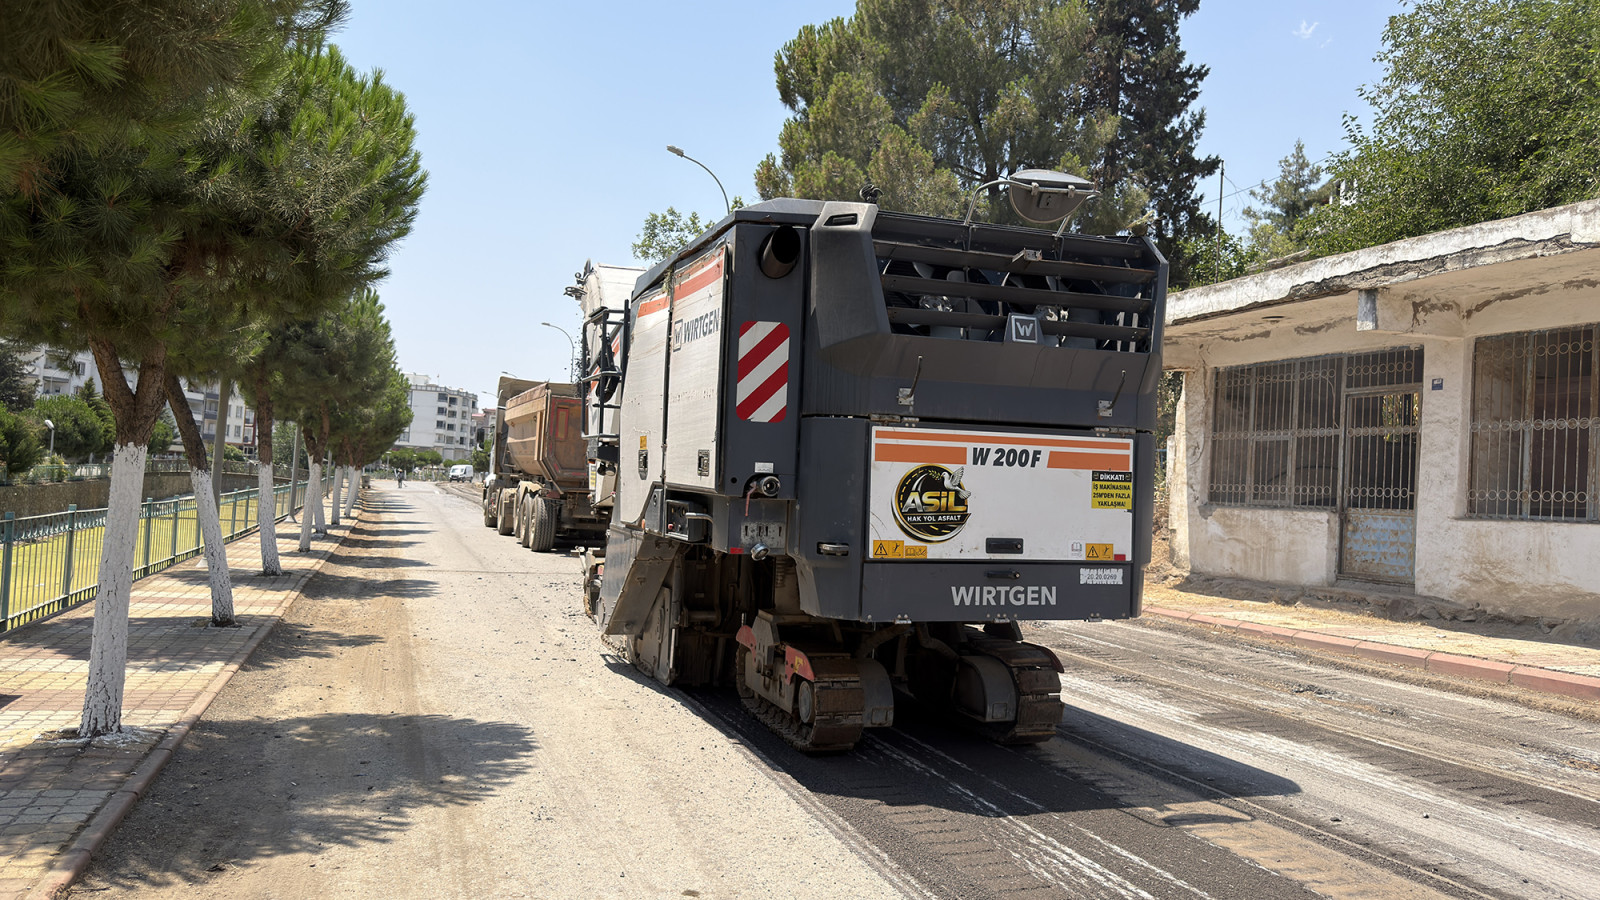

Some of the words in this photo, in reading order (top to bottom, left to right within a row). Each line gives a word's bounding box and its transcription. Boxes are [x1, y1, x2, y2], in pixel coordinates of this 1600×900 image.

[684, 307, 720, 343] WIRTGEN
[1015, 321, 1034, 337] W
[972, 447, 991, 466] W
[993, 447, 1042, 468] 200F
[1099, 473, 1125, 481] DİKKAT!
[951, 585, 1057, 606] WIRTGEN
